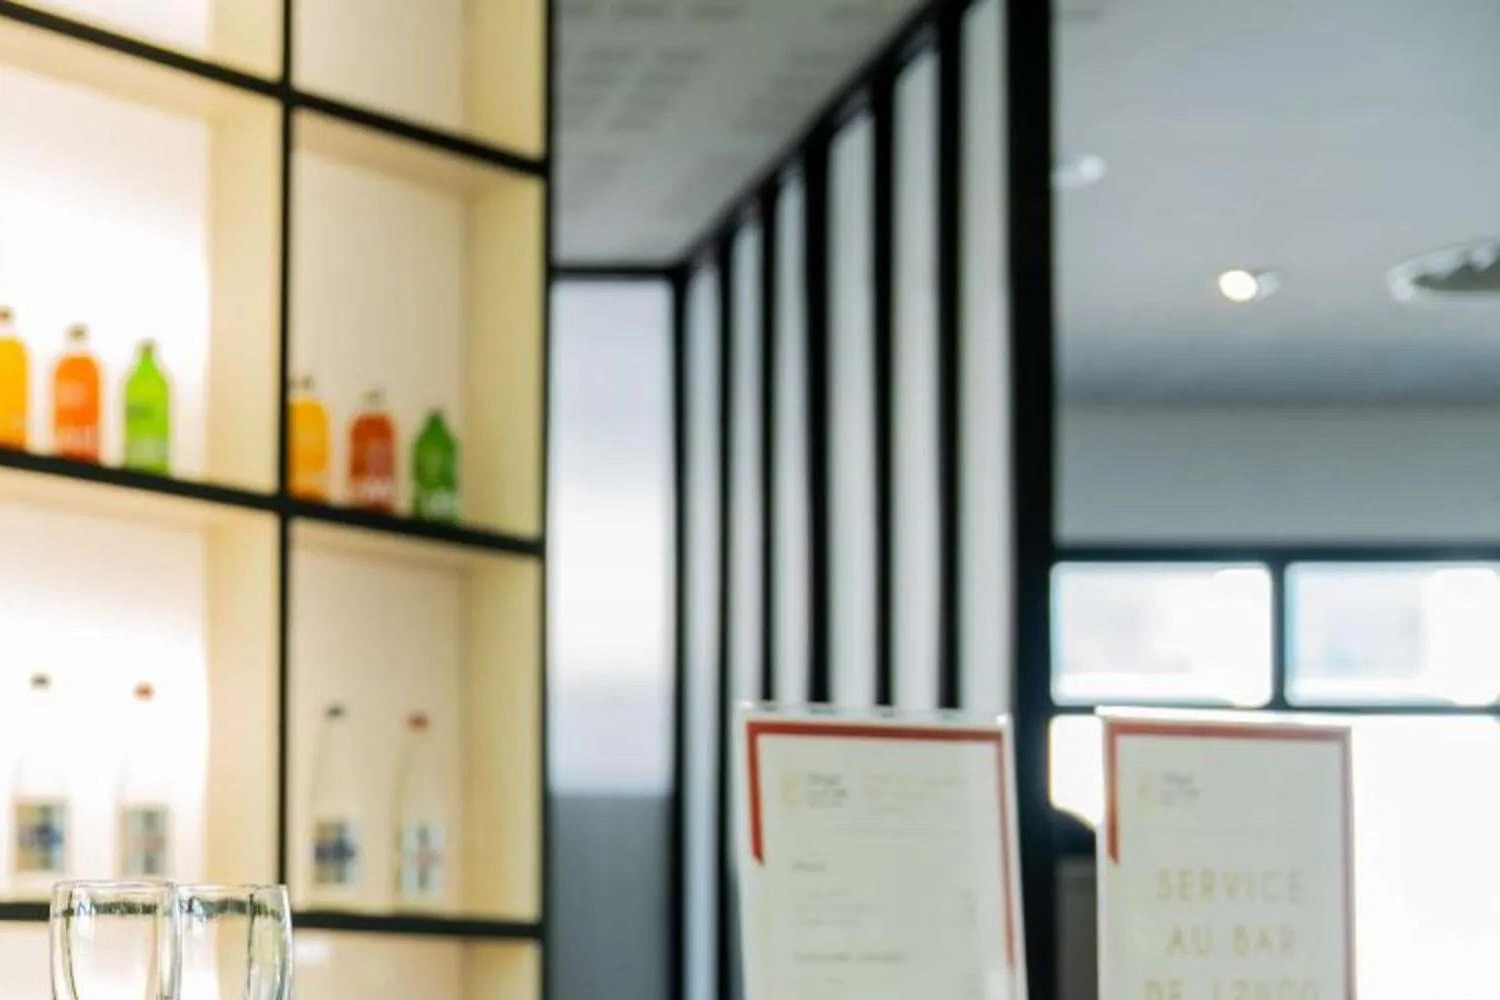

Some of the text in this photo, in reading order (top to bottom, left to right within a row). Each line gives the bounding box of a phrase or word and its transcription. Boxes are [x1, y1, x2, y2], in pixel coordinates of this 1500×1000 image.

[1156, 869, 1304, 902] SERVICE
[1166, 924, 1297, 957] AU BAR
